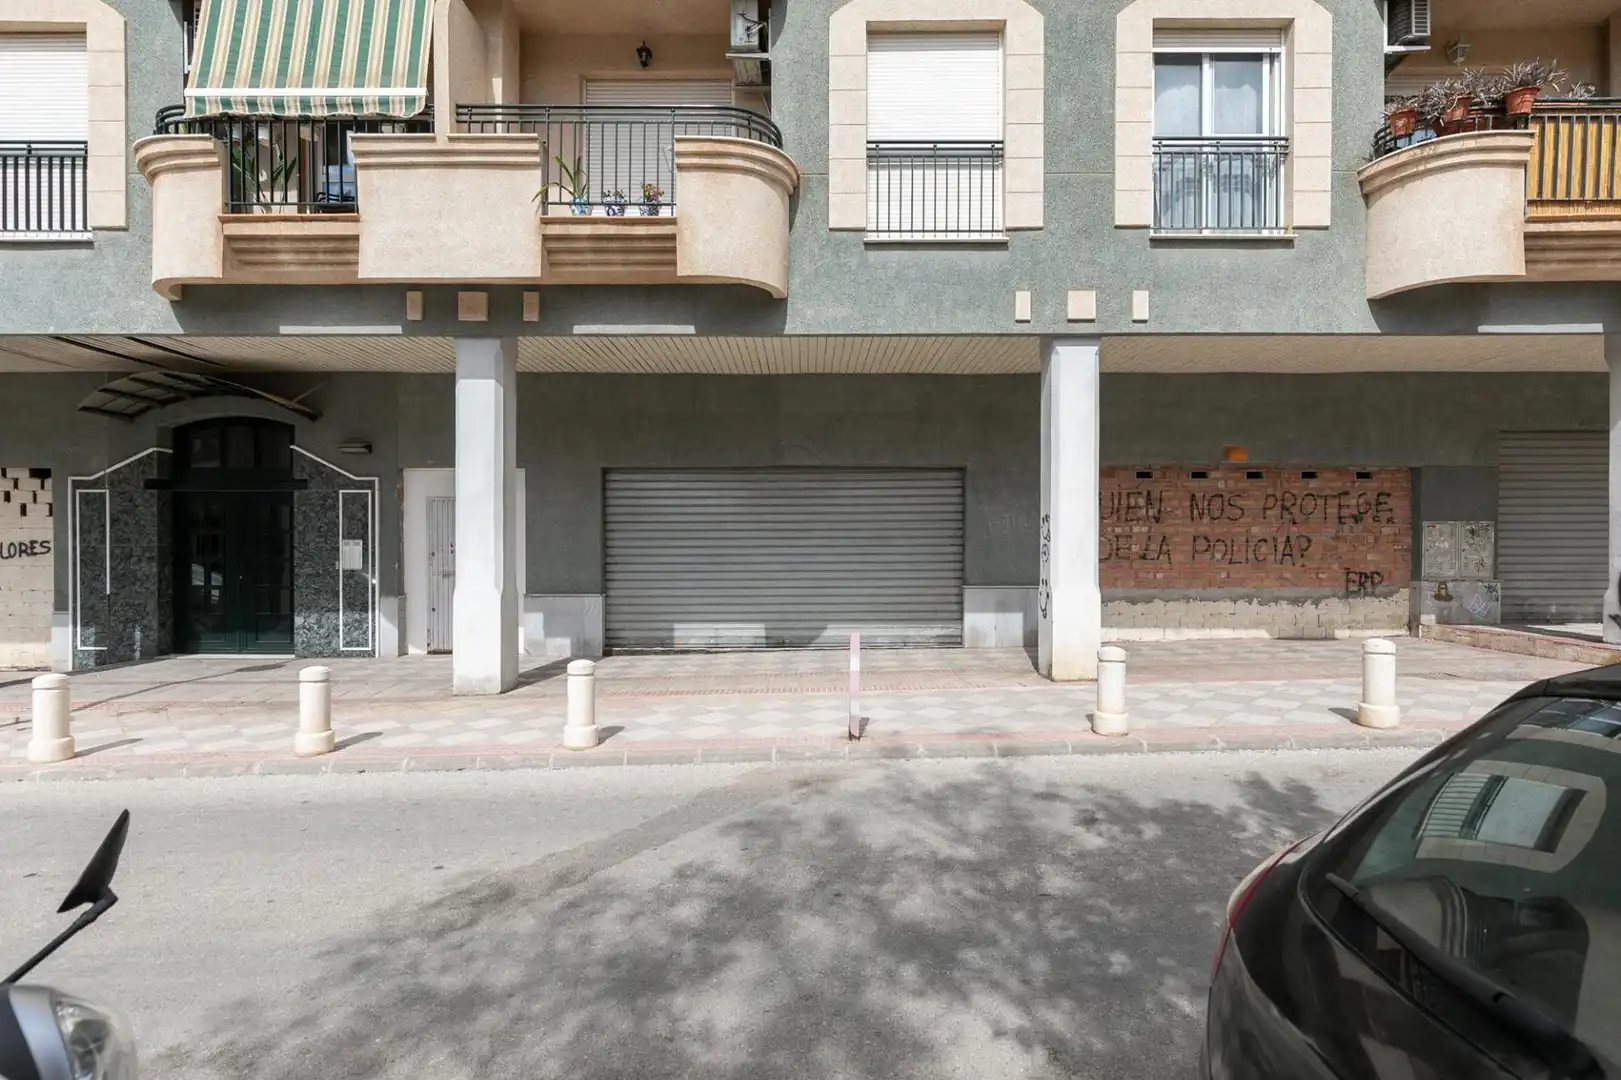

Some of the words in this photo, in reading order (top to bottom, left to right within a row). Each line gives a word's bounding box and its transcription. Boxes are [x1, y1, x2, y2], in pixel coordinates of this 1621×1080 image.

[1189, 492, 1245, 522] NOS
[1262, 490, 1394, 525] PROTEGE
[1139, 534, 1172, 565] LA
